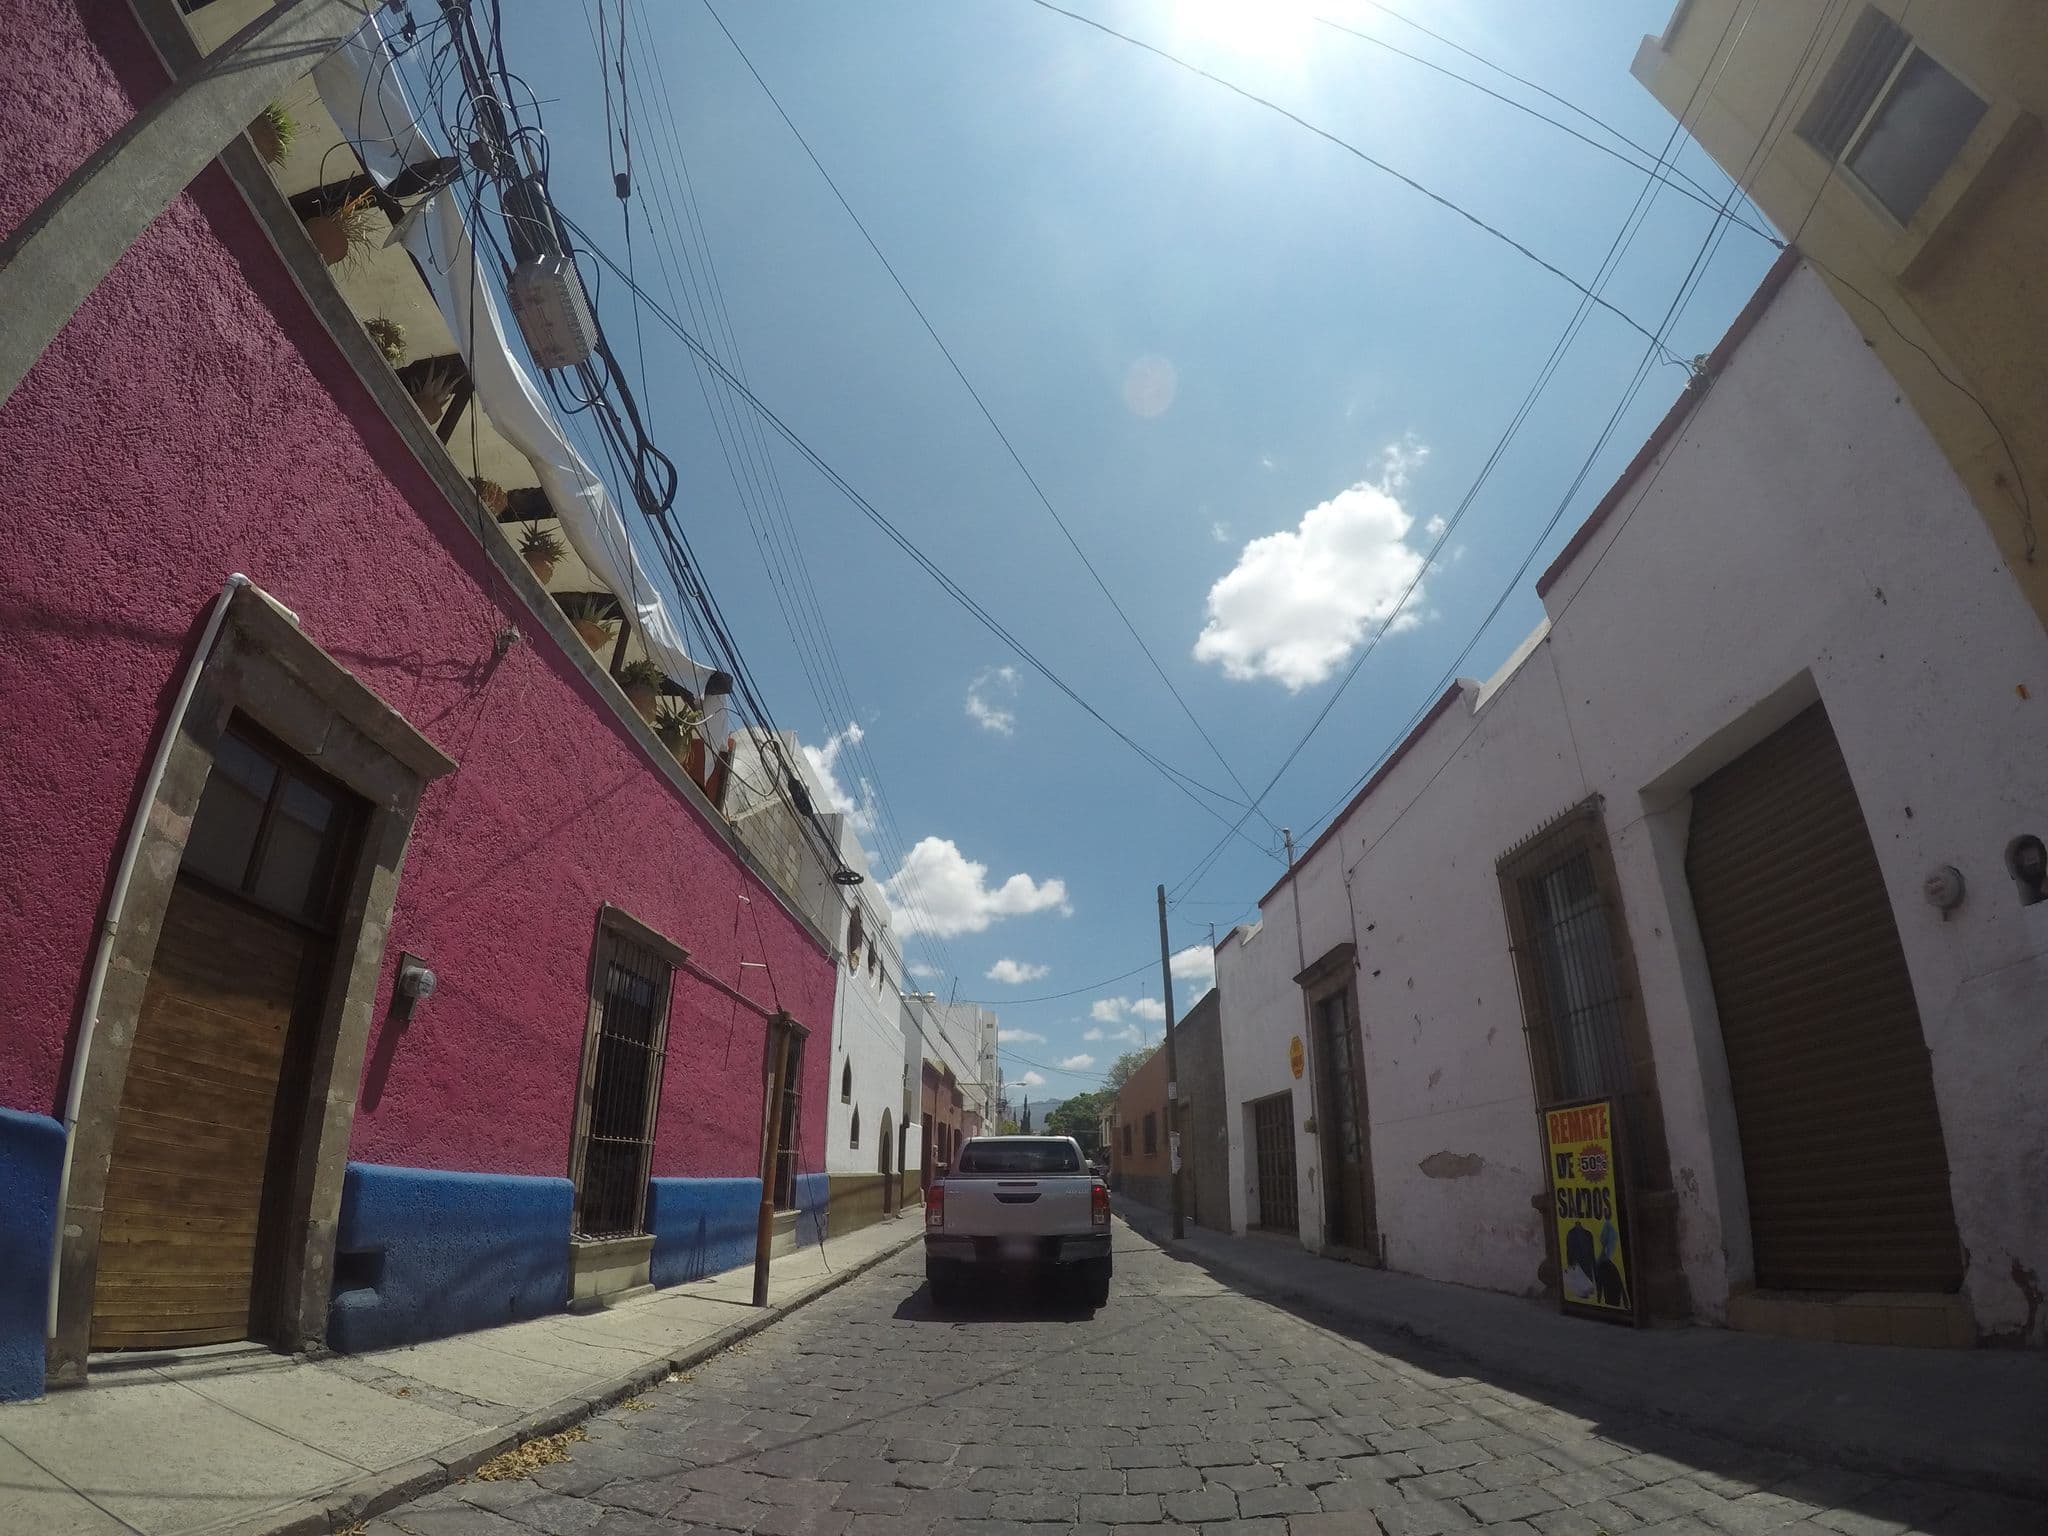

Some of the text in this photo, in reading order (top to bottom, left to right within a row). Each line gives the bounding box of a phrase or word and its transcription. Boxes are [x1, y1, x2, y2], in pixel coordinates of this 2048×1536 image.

[1549, 1106, 1608, 1144] REMATE
[1556, 1152, 1575, 1179] DE
[1581, 1154, 1607, 1172] 50%
[1557, 1186, 1611, 1220] SALDOS
